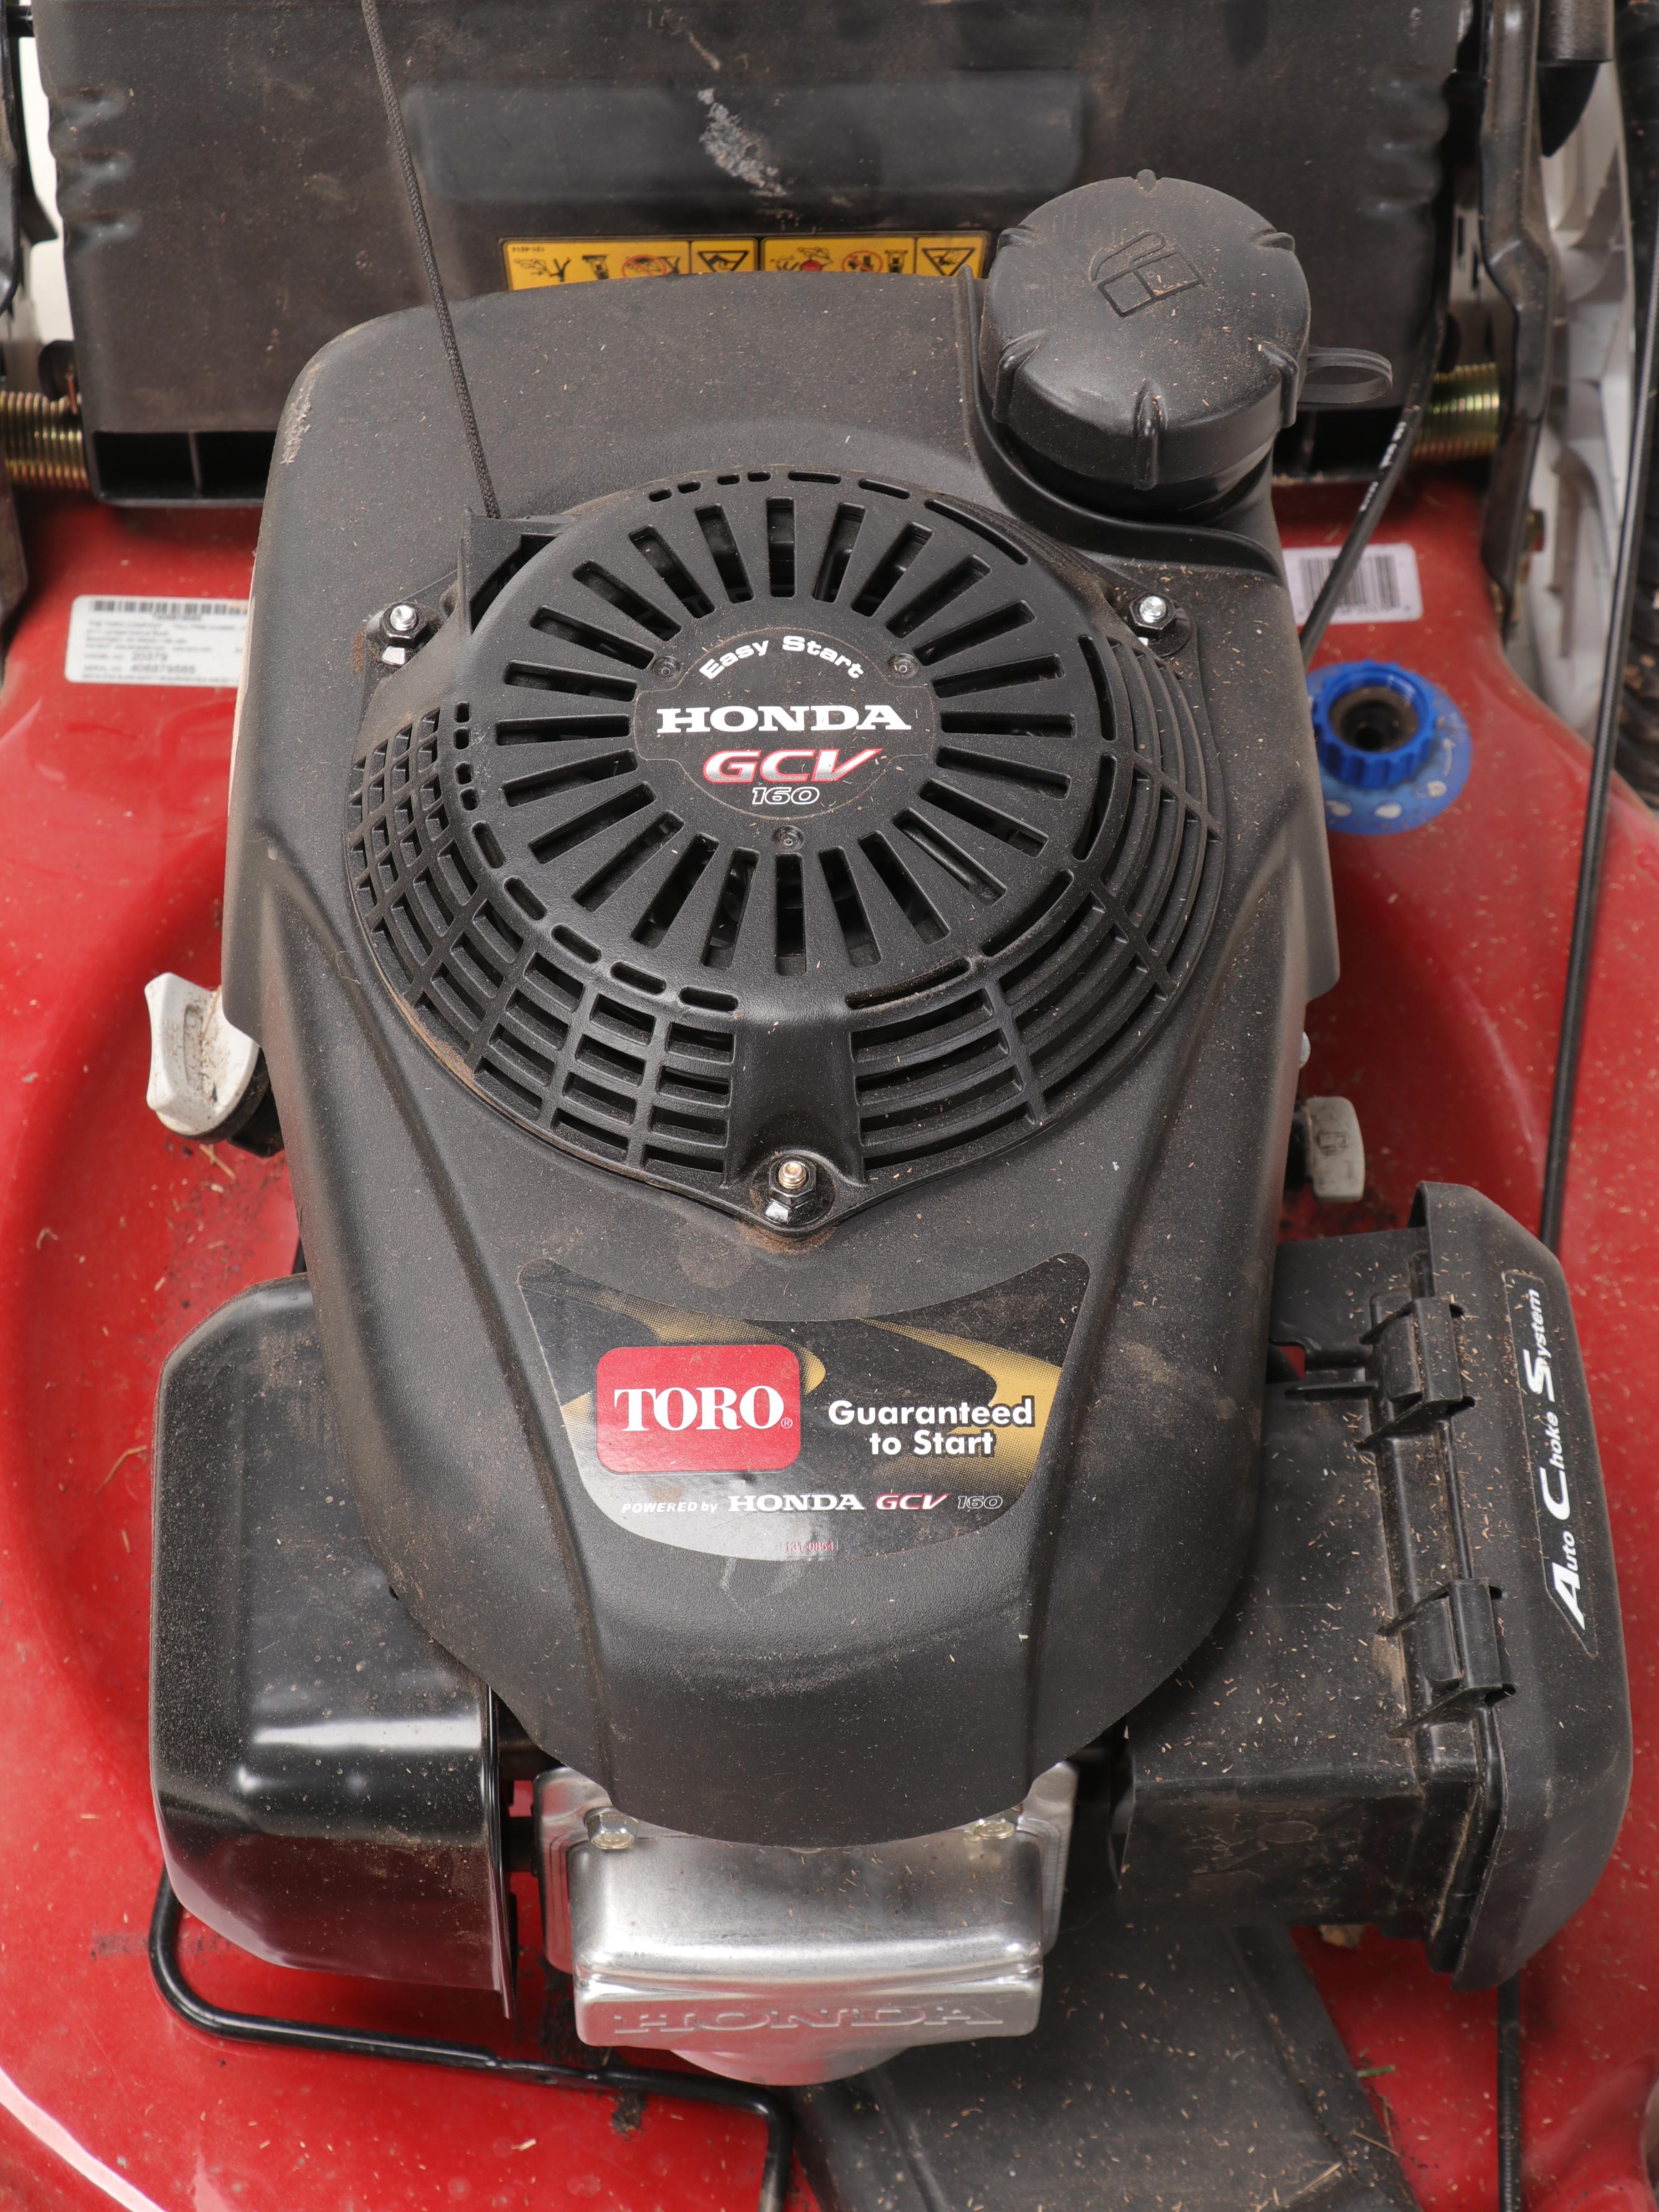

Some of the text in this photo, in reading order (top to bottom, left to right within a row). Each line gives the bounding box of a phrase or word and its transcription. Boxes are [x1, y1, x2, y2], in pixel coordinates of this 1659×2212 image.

[698, 635, 864, 680] Easy Start
[656, 704, 912, 734] HONDA
[702, 749, 884, 784] GCV
[752, 786, 820, 805] 160
[613, 1384, 784, 1432] TORO
[827, 1397, 1034, 1426] Guaranteed
[869, 1429, 995, 1456] to Start
[1523, 1288, 1586, 1631] Auto Choke System
[622, 1493, 1003, 1514] POWERED by HONDA GCV 160
[786, 1541, 834, 1553] 131-0854
[613, 2006, 1004, 2034] HONDA
